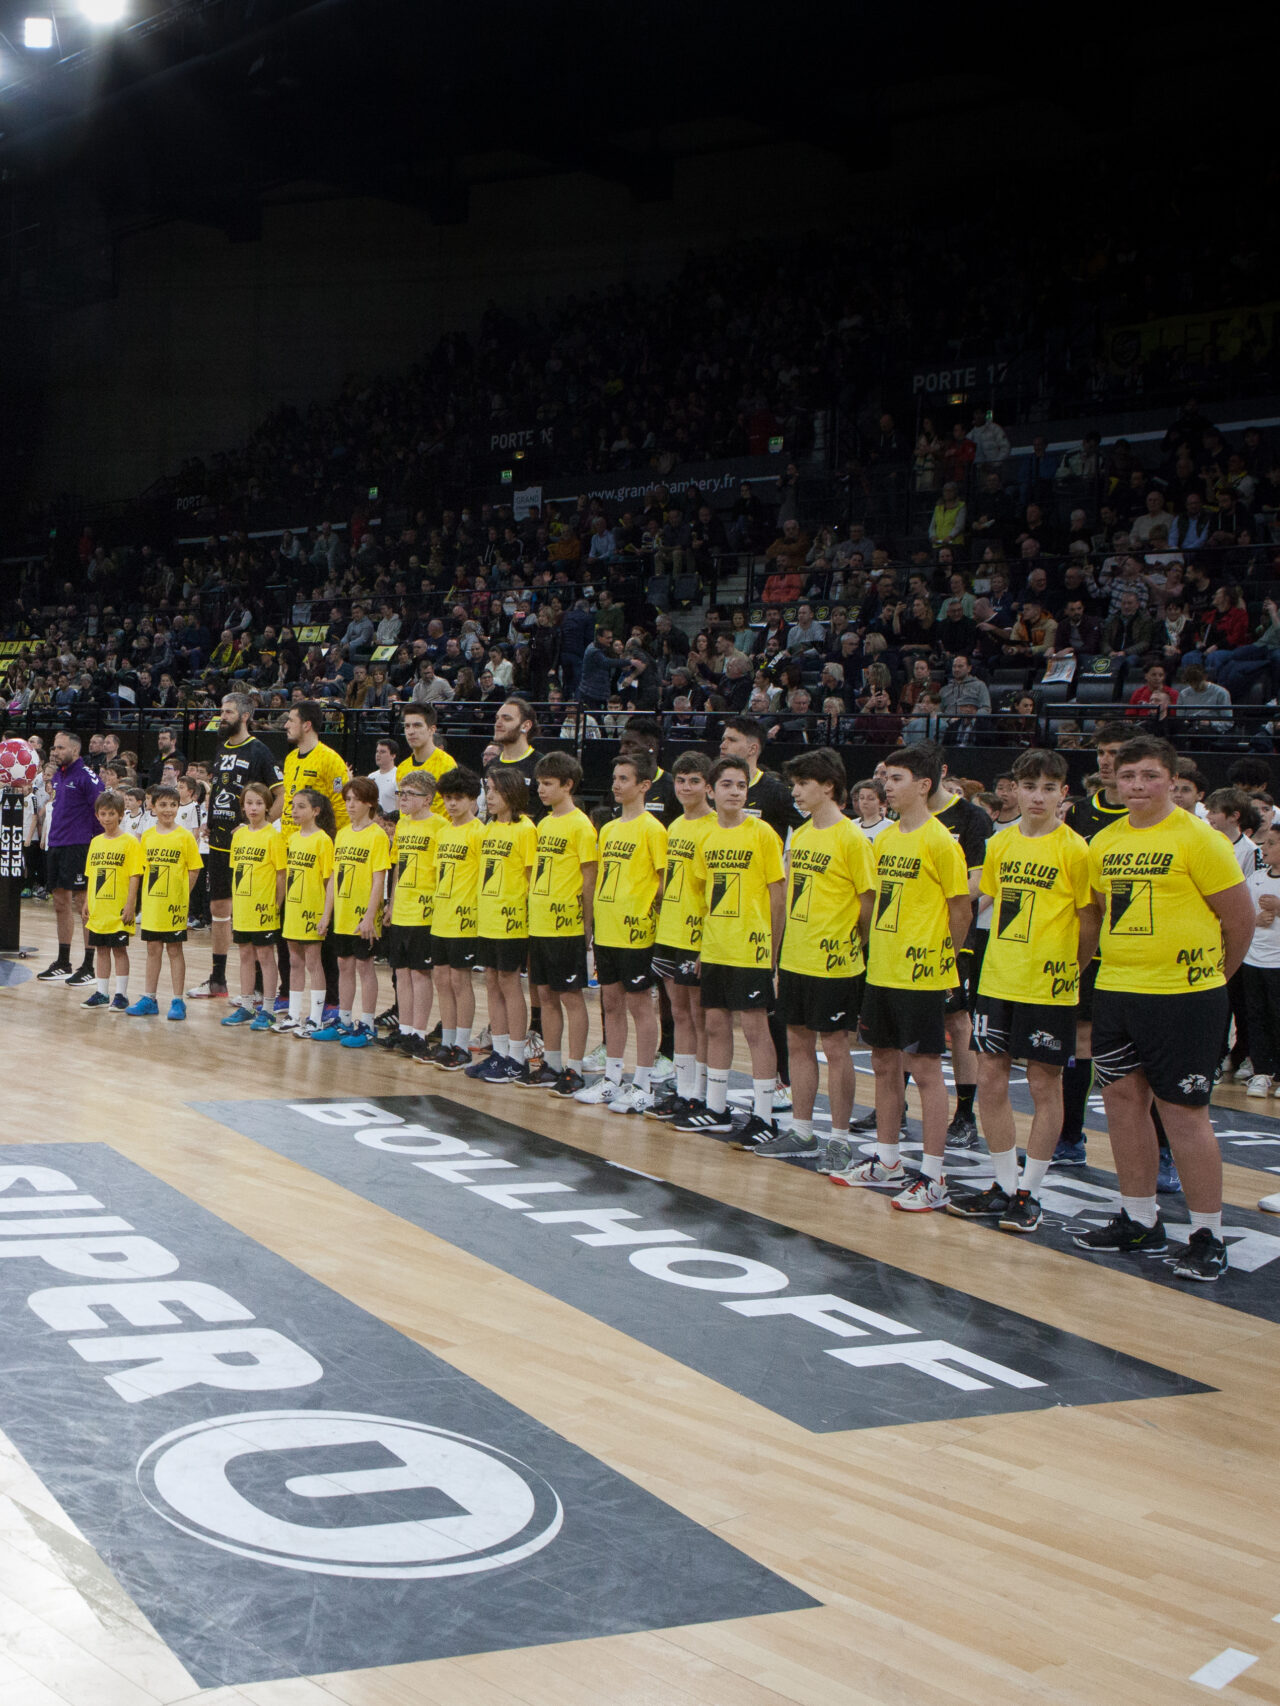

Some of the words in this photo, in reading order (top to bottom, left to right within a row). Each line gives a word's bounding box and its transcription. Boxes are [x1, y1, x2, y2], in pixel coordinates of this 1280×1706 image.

[913, 366, 976, 394] PORTE
[490, 429, 534, 451] PORTE
[220, 754, 237, 771] 23
[294, 766, 300, 781] 1
[411, 836, 430, 845] CLUB
[614, 841, 636, 853] CLUB
[1, 824, 10, 877] SELECT
[11, 824, 23, 877] SELECT
[106, 852, 125, 861] CLUB
[160, 849, 181, 858] CLUB
[246, 847, 266, 856] CLUB
[347, 847, 370, 857] CLUB
[450, 844, 468, 854] CLUB
[726, 850, 753, 861] CLUB
[297, 853, 317, 863] CLUB
[878, 854, 894, 867] ANS
[897, 855, 921, 870] CLUB
[1103, 853, 1133, 867] FANS
[1135, 852, 1173, 867] CLUB
[1023, 862, 1059, 880] CLUB
[224, 1440, 473, 1530] U
